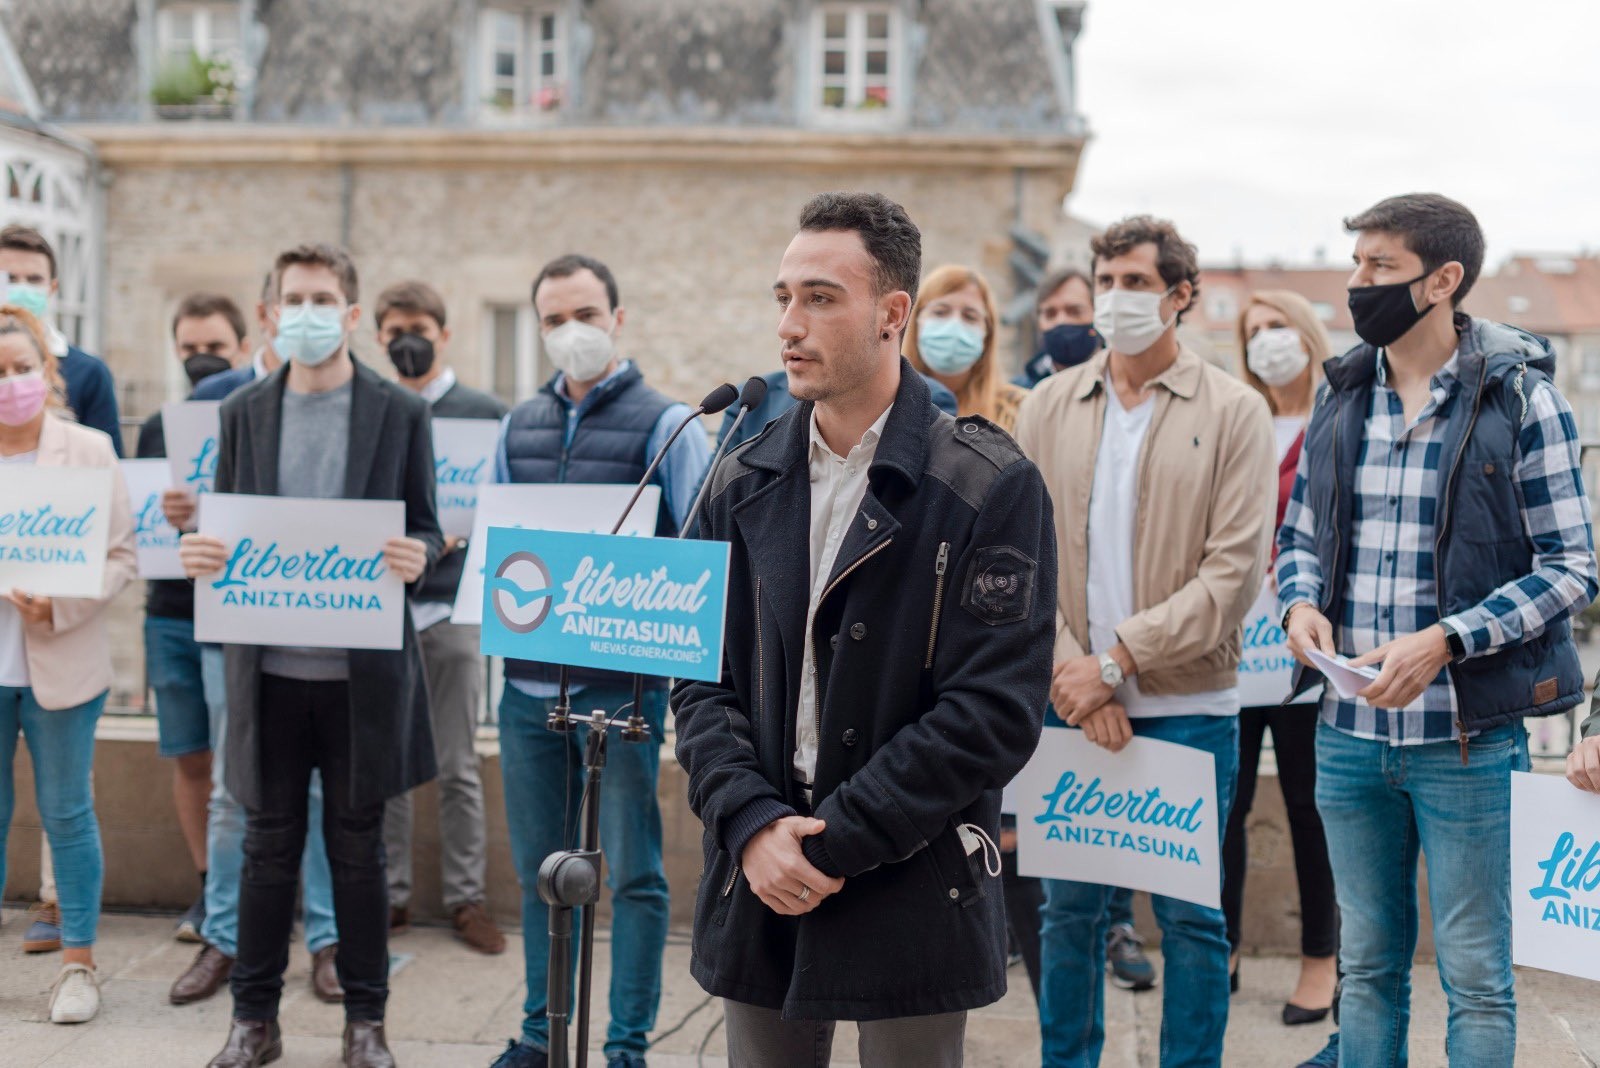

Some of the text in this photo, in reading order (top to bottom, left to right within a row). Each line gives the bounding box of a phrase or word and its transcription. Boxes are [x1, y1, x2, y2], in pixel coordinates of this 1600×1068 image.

[212, 538, 387, 589] Libertad
[223, 590, 382, 611] ANIZTASUNA
[554, 556, 711, 616] Libertad
[562, 614, 701, 647] ANIZTASUNA
[590, 641, 627, 656] NUEVAS
[1034, 771, 1204, 833] Libertad
[1046, 824, 1201, 865] ANIZTASUNA
